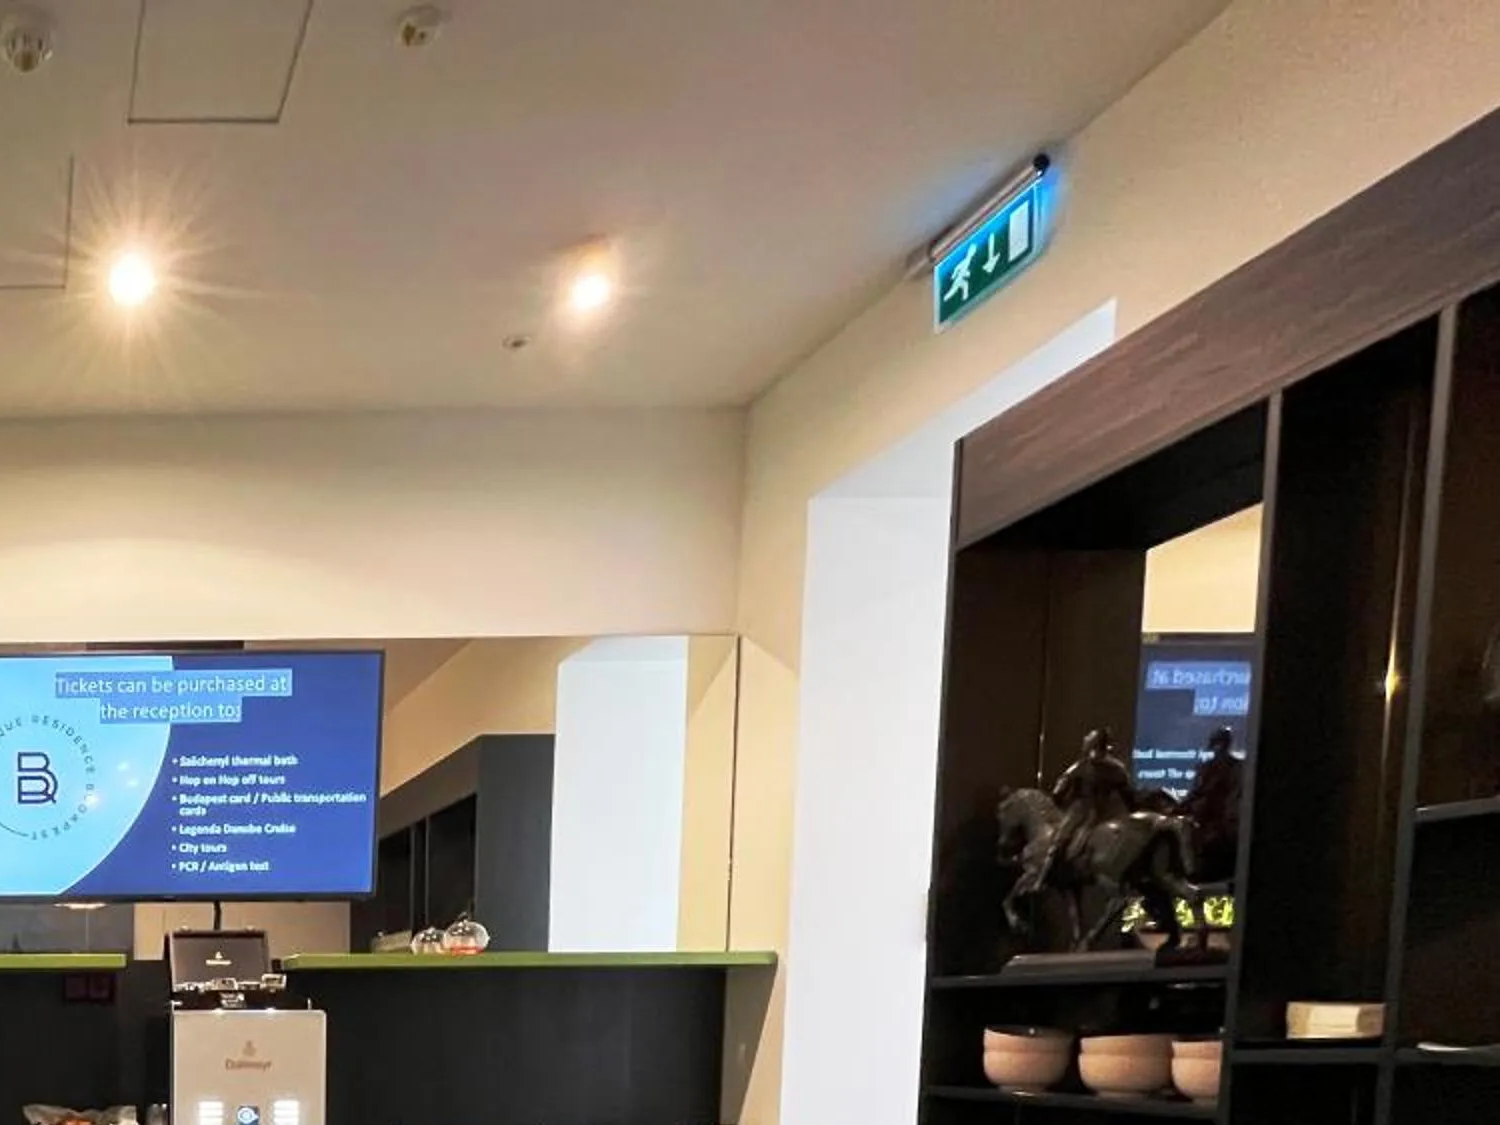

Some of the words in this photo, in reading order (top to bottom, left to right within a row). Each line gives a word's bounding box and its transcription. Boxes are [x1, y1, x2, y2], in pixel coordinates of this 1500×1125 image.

[56, 677, 113, 694] Tickets
[117, 680, 147, 693] can
[152, 677, 174, 693] be
[177, 676, 265, 696] purchased
[270, 677, 287, 691] at
[100, 703, 132, 720] the
[133, 703, 214, 721] reception
[231, 755, 272, 766] thermal
[274, 755, 299, 766] bath
[179, 774, 201, 787] Hop
[218, 774, 240, 787] Hop
[241, 773, 257, 785] off
[258, 774, 286, 785] tours
[179, 793, 227, 806] Budapest
[229, 793, 251, 804] card
[261, 793, 292, 804] Public
[293, 792, 367, 806] transportation
[179, 806, 207, 817] cards
[224, 823, 262, 834] Danube
[264, 823, 297, 834] Cruise
[179, 843, 199, 855] City
[201, 843, 228, 853] tours
[179, 861, 199, 872] PCR
[208, 860, 248, 873] Antigen
[250, 861, 270, 871] test
